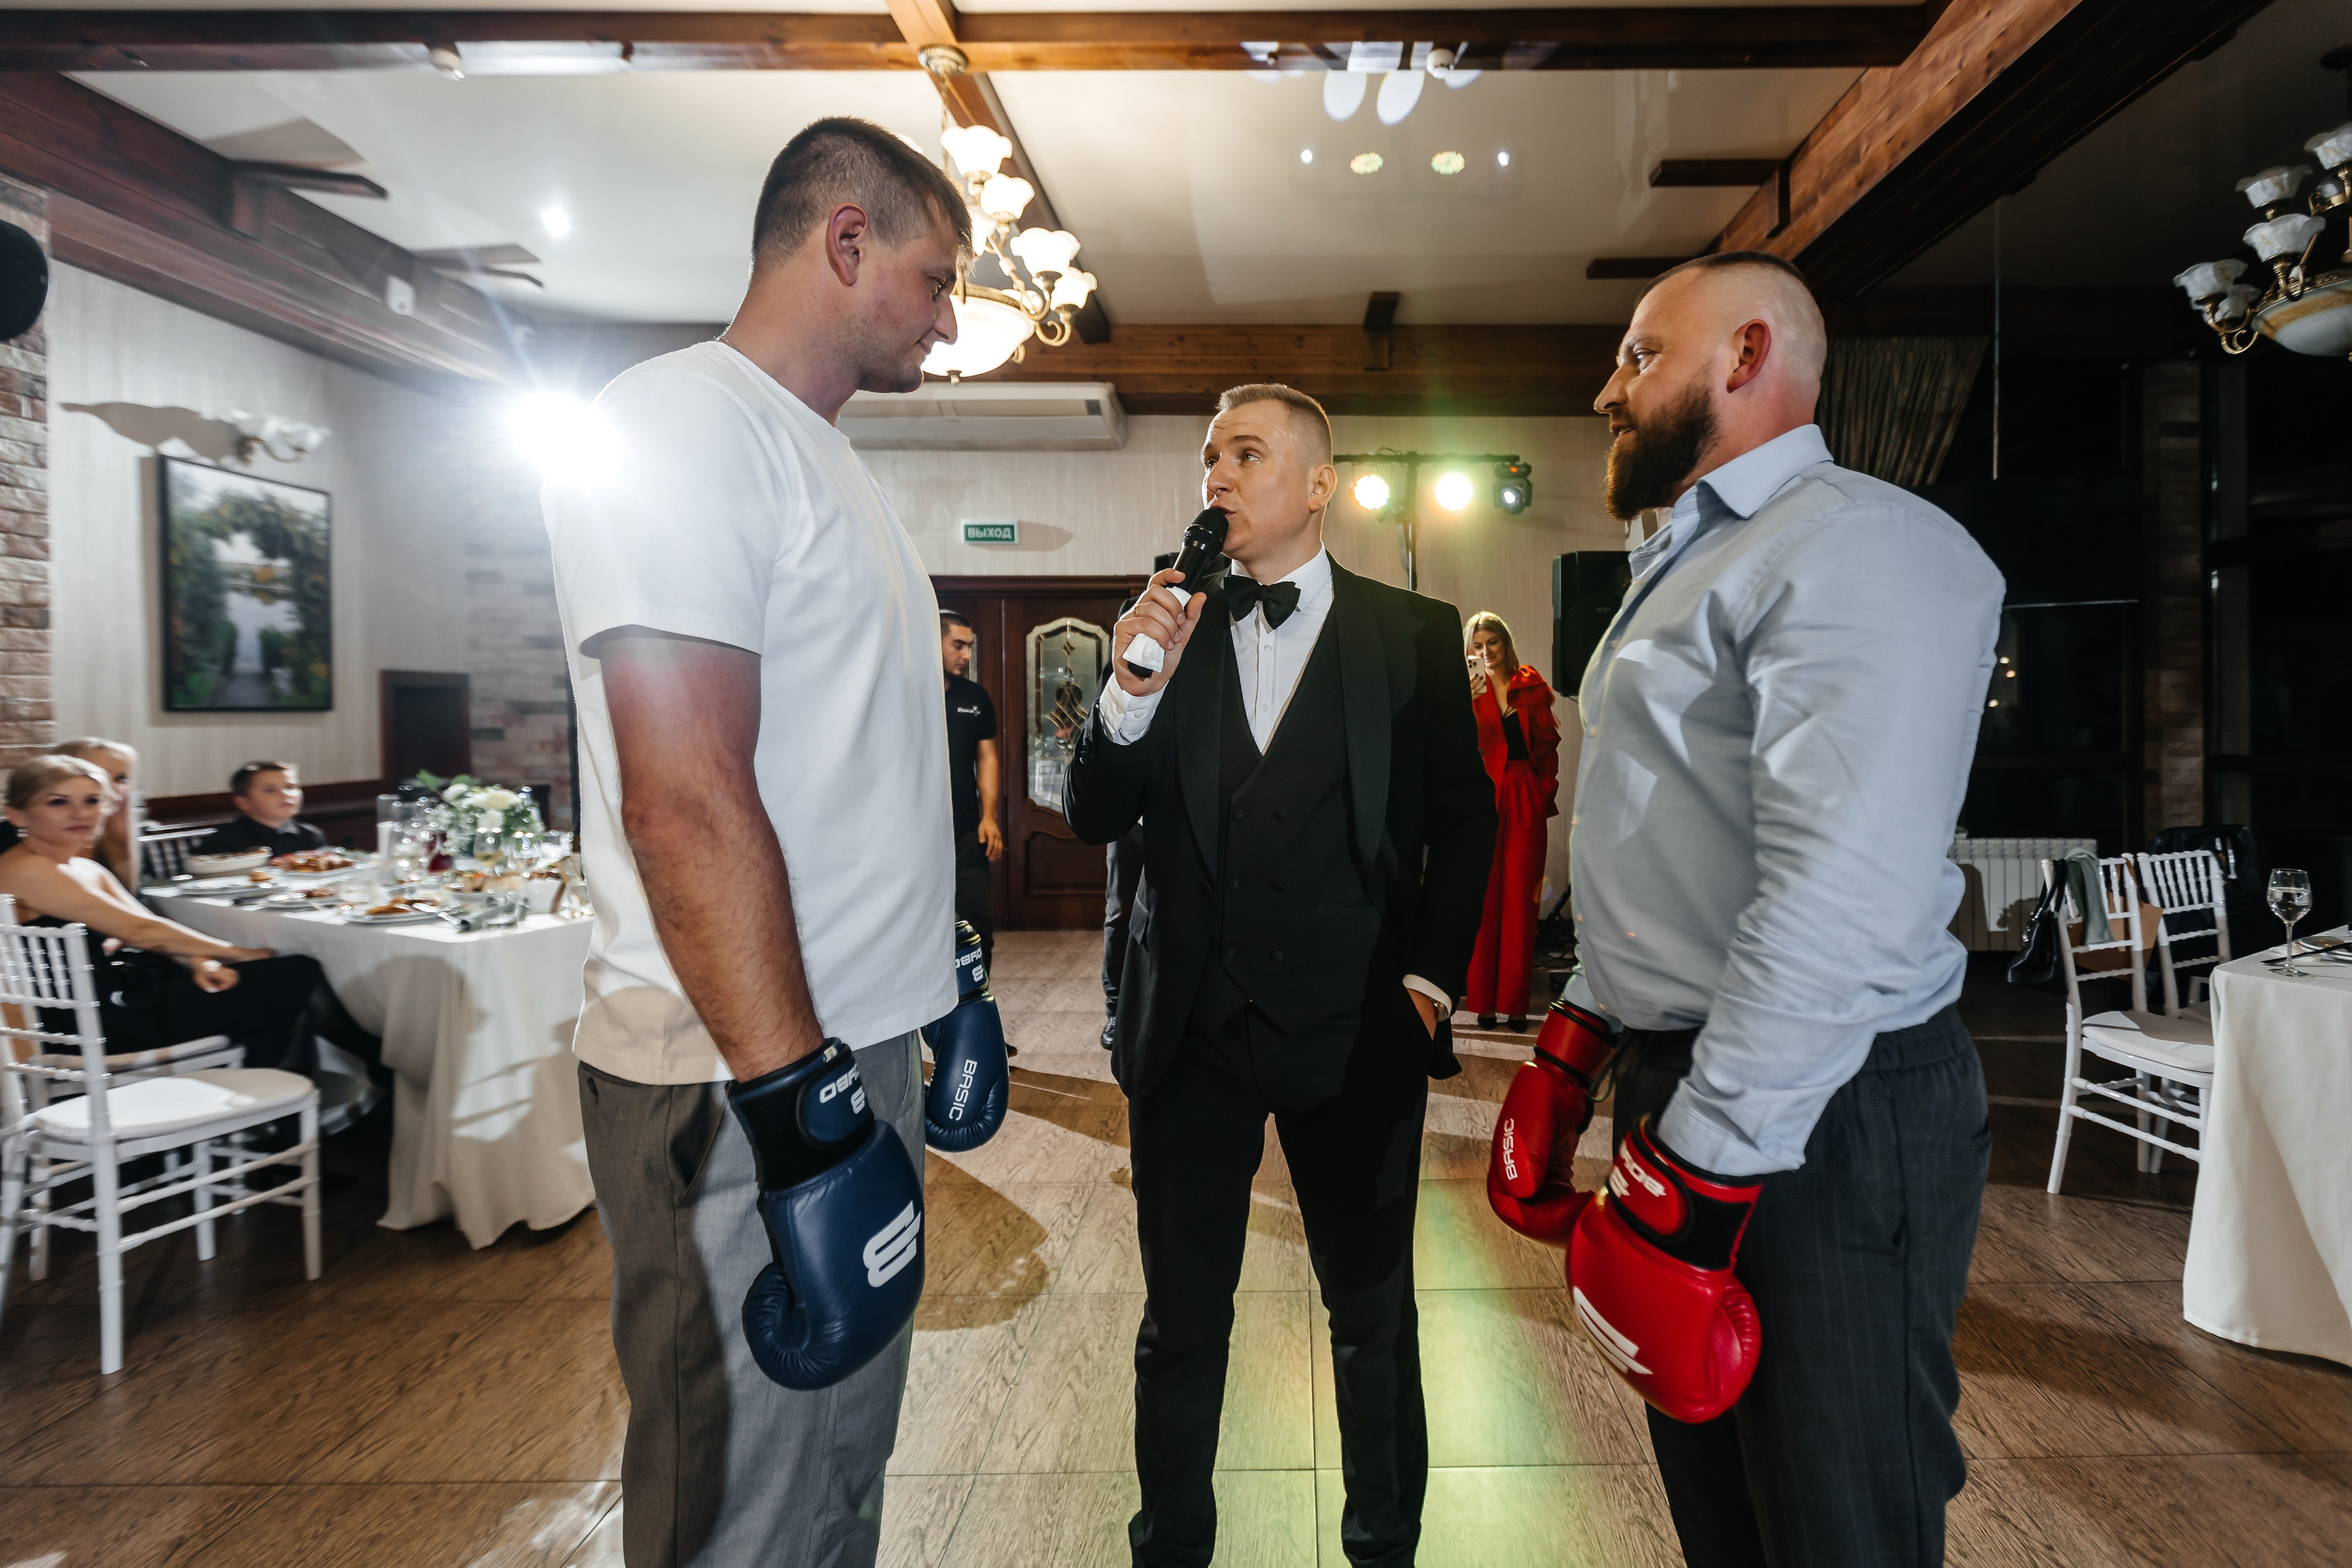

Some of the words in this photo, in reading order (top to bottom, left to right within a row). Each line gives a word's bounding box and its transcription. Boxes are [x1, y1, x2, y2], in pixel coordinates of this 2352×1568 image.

[967, 527, 1012, 539] ВЫХОД
[948, 1059, 978, 1121] BASIC
[1502, 1117, 1519, 1181] BASIC
